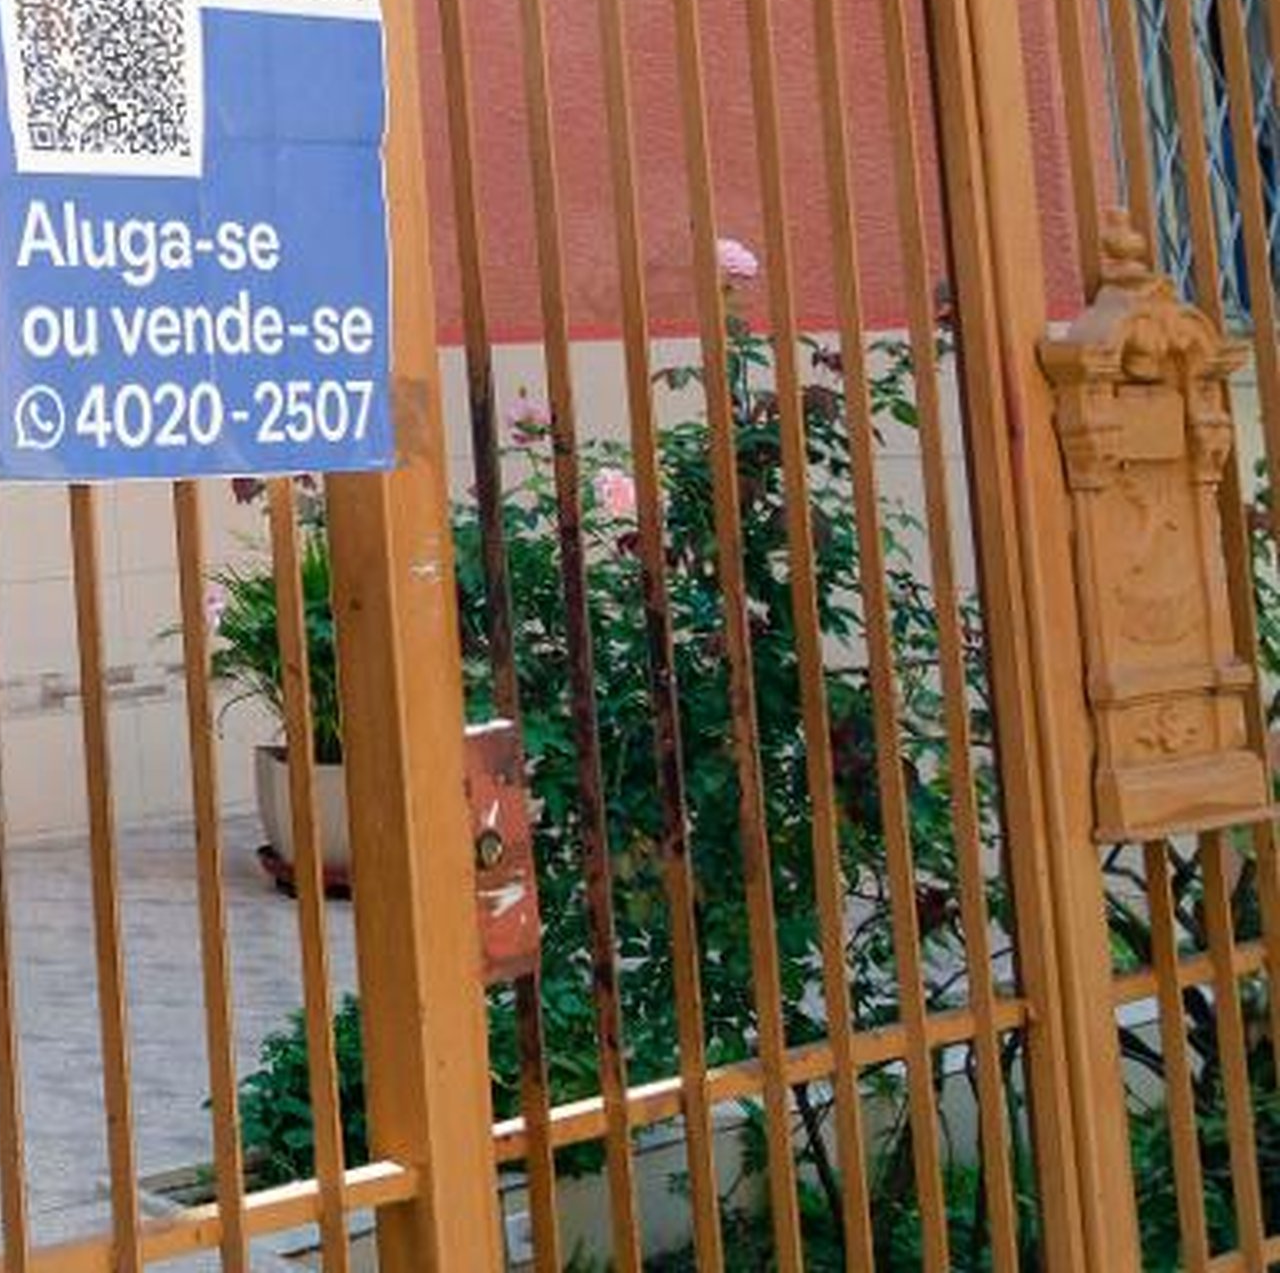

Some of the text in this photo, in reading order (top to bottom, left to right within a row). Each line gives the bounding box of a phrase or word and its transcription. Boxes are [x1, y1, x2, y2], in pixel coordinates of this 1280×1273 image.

[16, 200, 280, 286] Aluga-se
[22, 290, 374, 357] ou vende-se
[76, 380, 374, 448] 4020-2507
